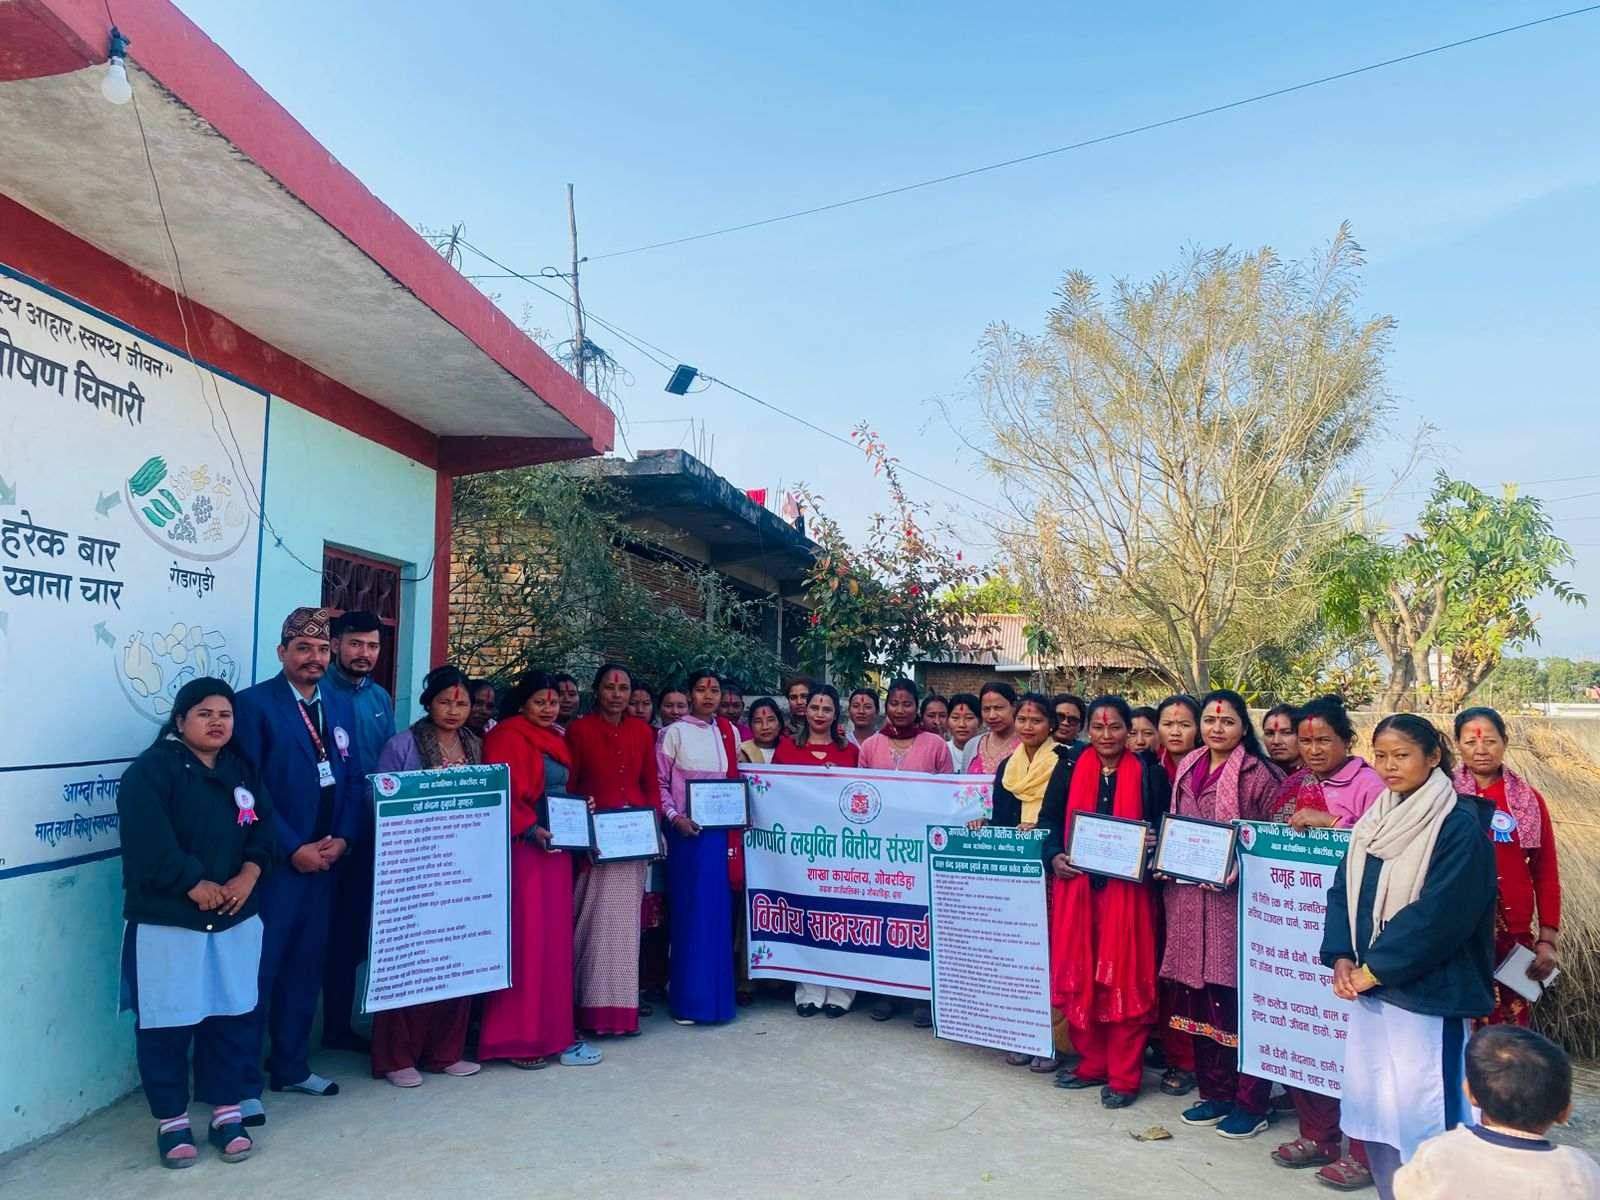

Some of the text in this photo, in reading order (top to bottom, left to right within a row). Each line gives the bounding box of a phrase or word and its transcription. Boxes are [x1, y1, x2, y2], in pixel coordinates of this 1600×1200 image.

[79, 325, 121, 362] स्वस्थ
[74, 360, 145, 426] चिनारी
[1, 510, 121, 573] हरेक बार
[2, 566, 124, 610] खाना चार
[169, 561, 215, 598] गेडागुडी
[745, 823, 924, 864] गणपति लघुवित्त वित्तीय संस्था
[807, 868, 830, 882] शाखा
[832, 867, 872, 885] कार्यालय,
[1270, 867, 1322, 889] समूह गान
[752, 893, 805, 936] वित्तीय
[807, 910, 883, 946] साक्षरता
